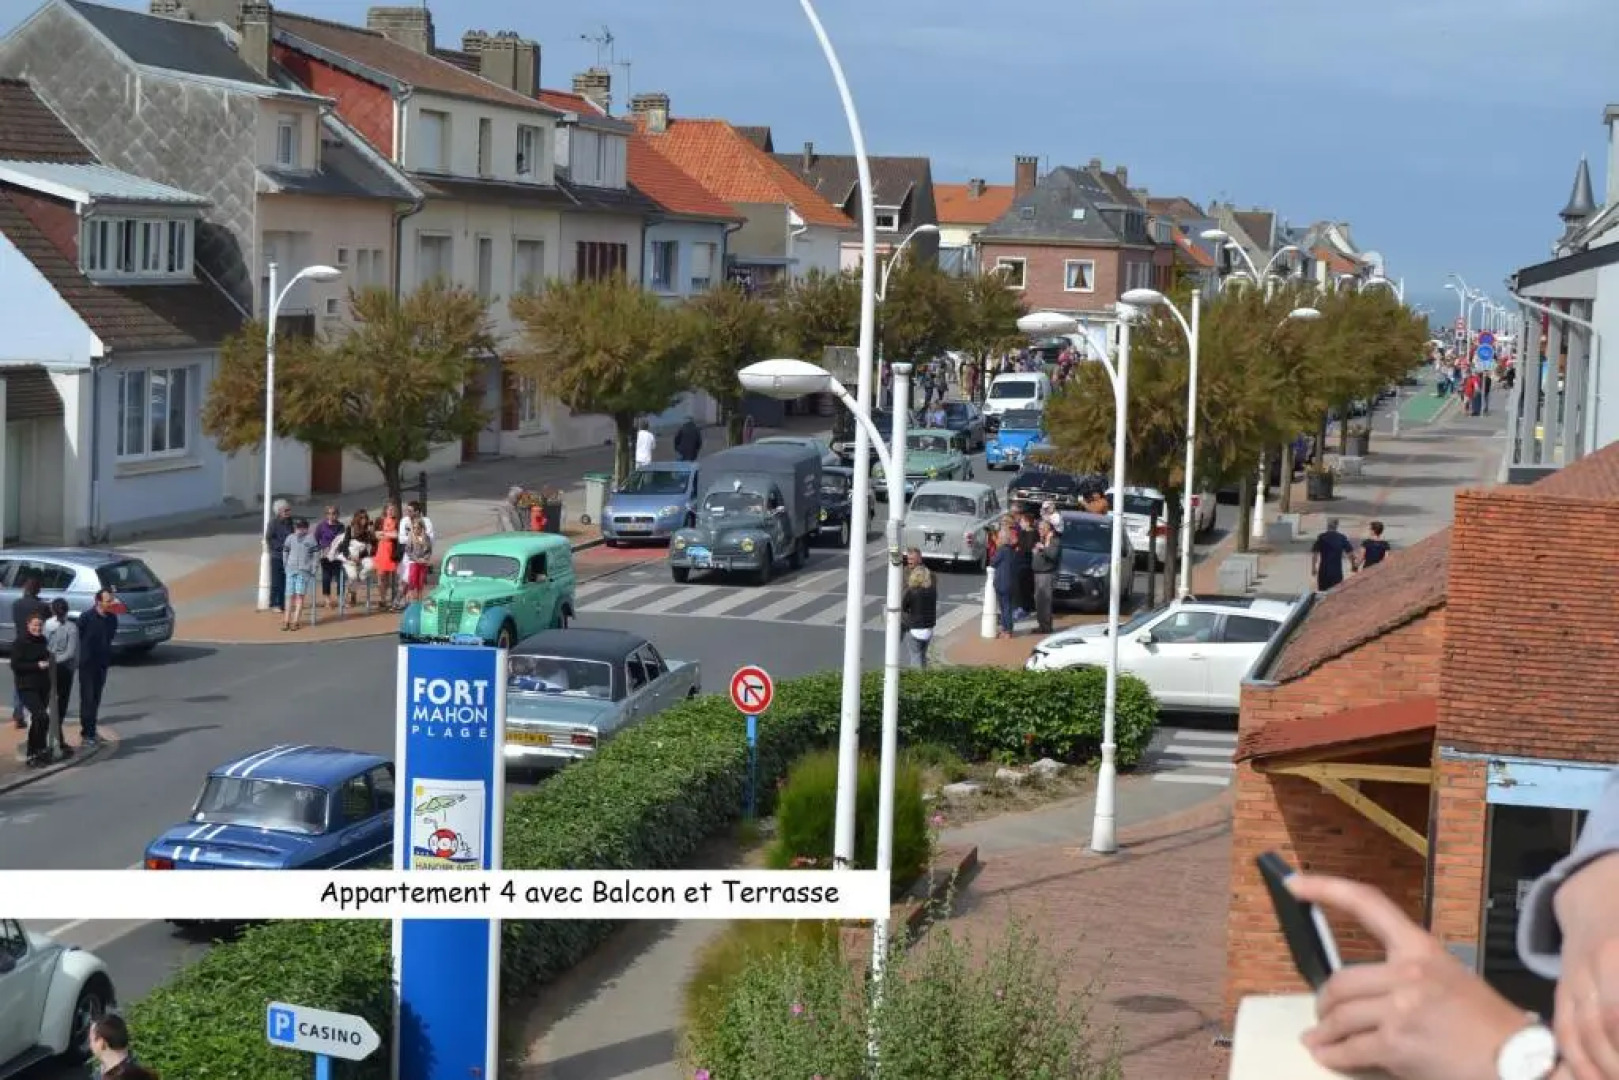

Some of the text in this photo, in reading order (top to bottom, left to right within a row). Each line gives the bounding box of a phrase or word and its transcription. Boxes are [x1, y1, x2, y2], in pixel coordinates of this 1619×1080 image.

[413, 676, 488, 705] FORT
[412, 705, 488, 724] MAHON
[412, 725, 488, 738] PLAGE
[276, 1012, 362, 1046] P CASINO
